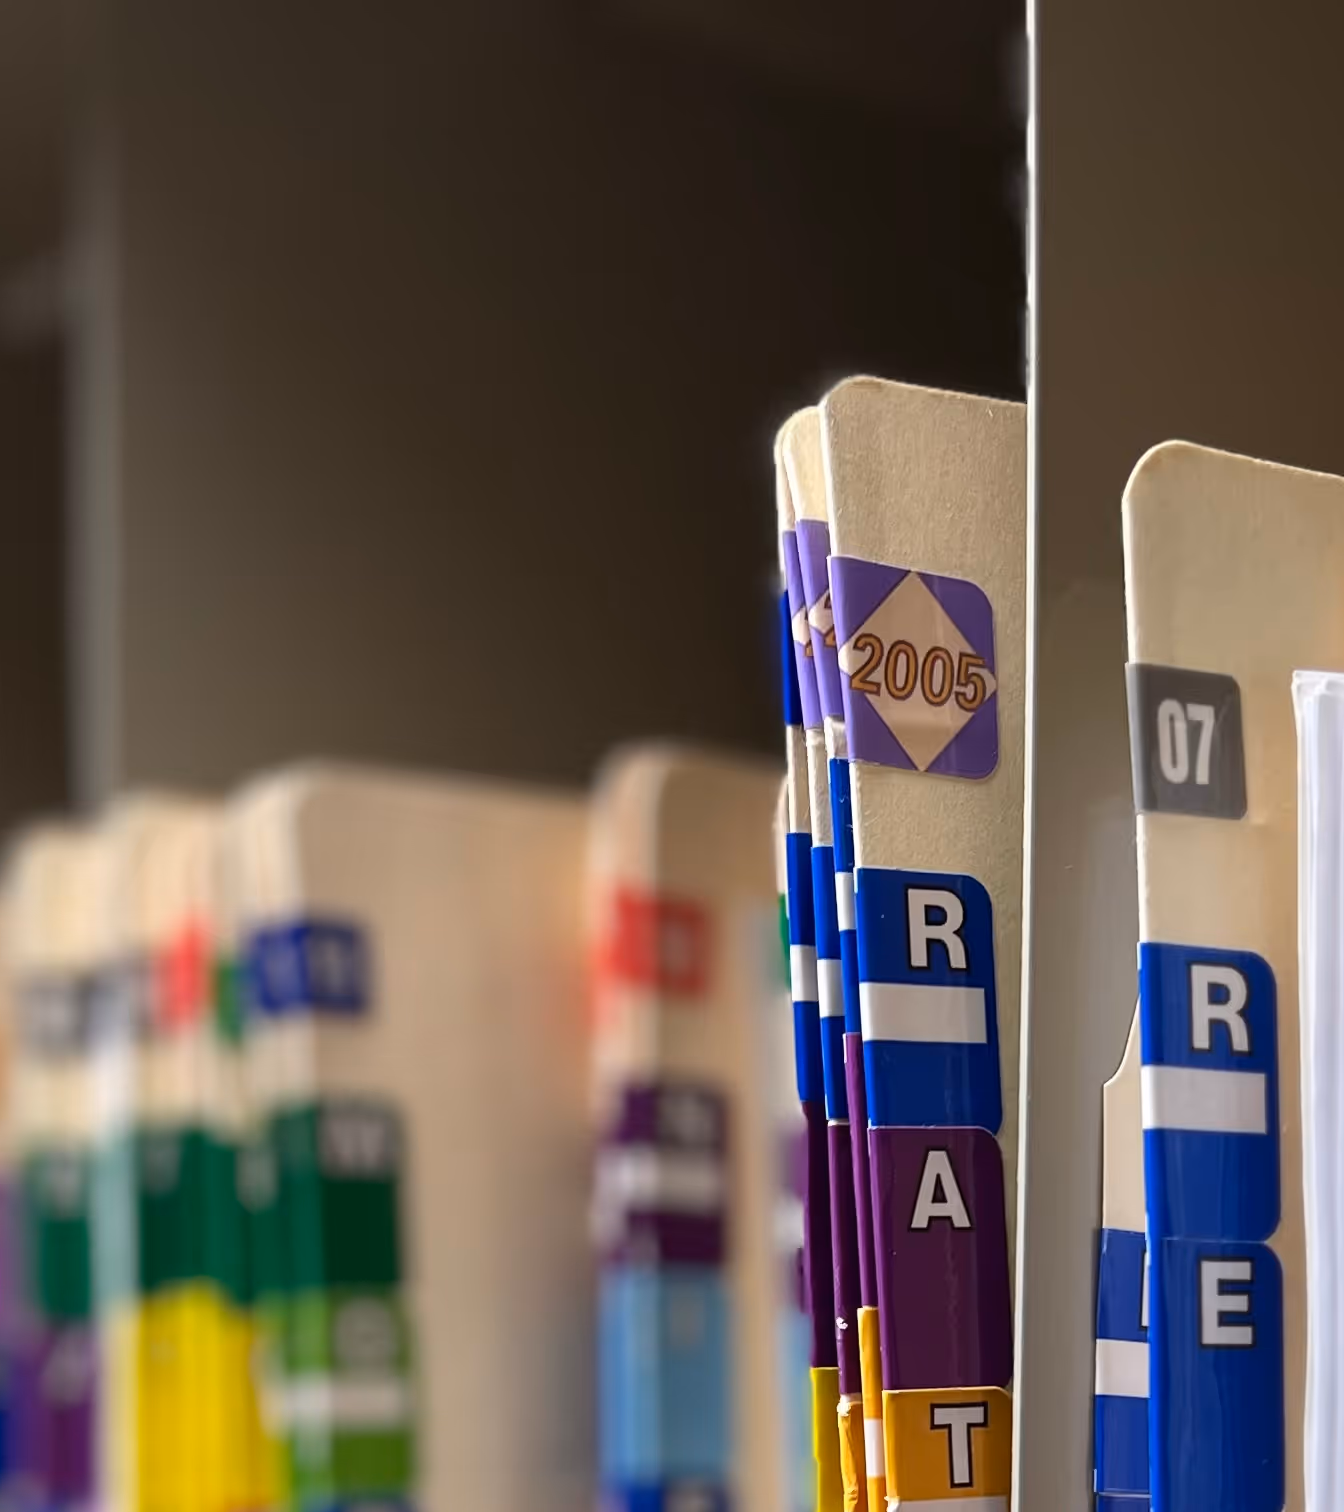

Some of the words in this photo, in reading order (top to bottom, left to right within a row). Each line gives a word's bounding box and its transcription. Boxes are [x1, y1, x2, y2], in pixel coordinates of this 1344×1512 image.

[849, 634, 987, 711] 2005
[1157, 700, 1216, 785] 07
[905, 886, 968, 971] R
[1190, 962, 1253, 1053] R
[909, 1149, 973, 1231] A
[1198, 1257, 1255, 1349] E
[930, 1402, 988, 1487] T
